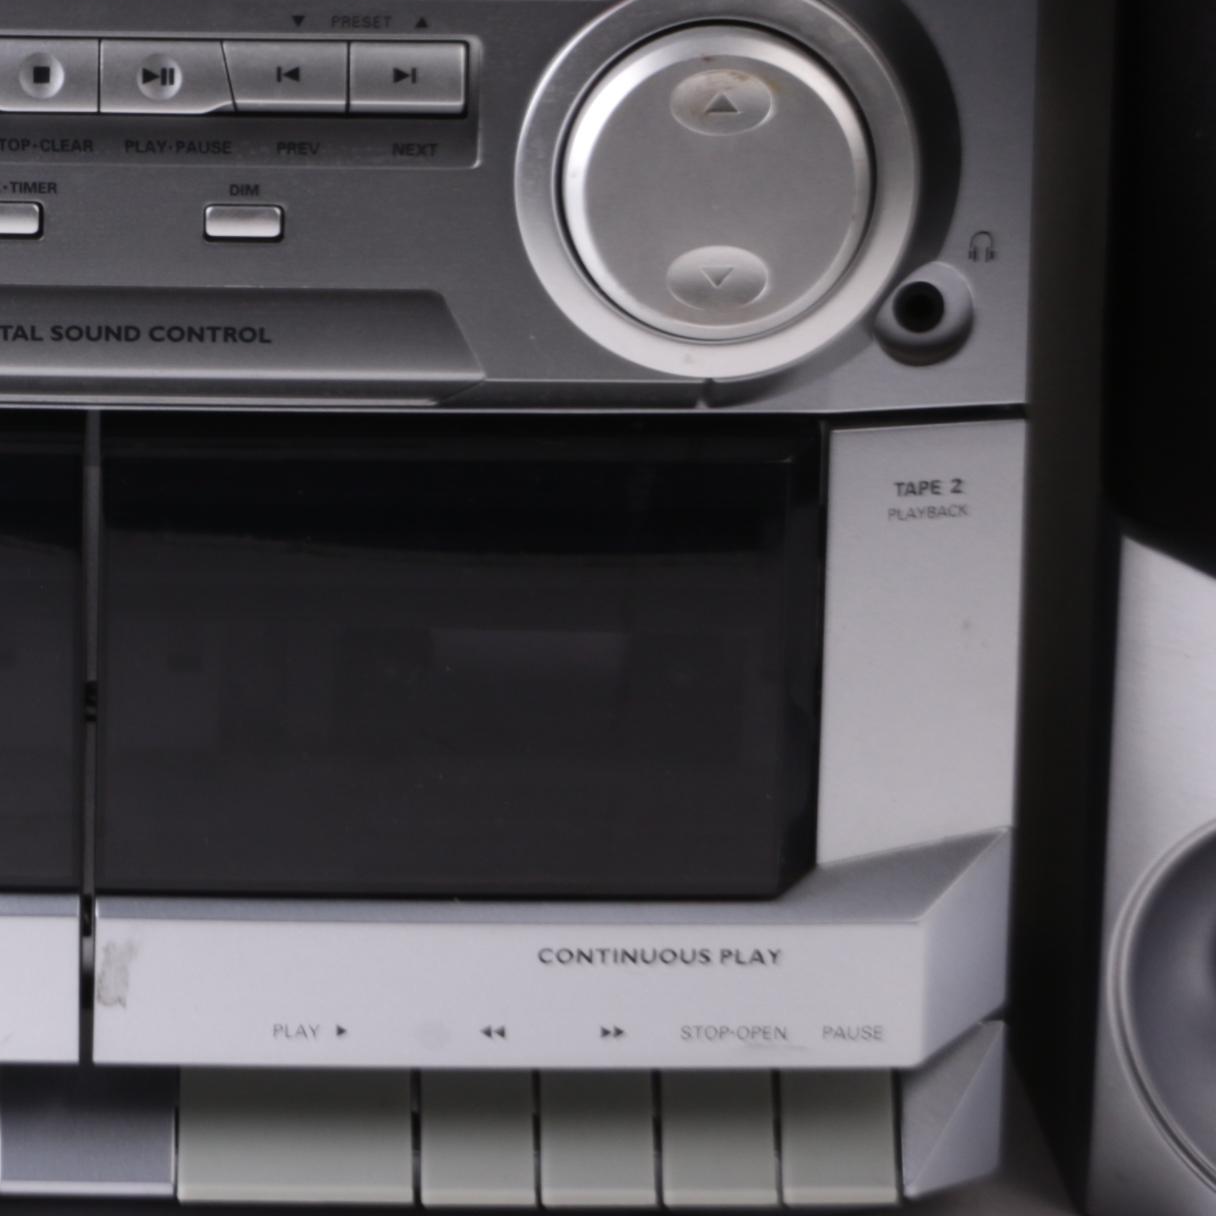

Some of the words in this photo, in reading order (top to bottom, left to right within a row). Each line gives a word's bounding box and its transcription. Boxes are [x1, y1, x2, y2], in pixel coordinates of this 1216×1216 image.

[331, 15, 392, 29] PRESET
[276, 141, 320, 156] PREV
[392, 142, 438, 157] NEXT
[229, 183, 259, 197] DIM
[49, 325, 140, 343] SOUND
[148, 325, 272, 344] CONTROL
[893, 479, 942, 497] TAPE
[950, 477, 964, 494] 2
[887, 504, 968, 522] PLAYBACK
[537, 947, 712, 965] CONTINUOUS
[719, 948, 782, 966] PLAY
[272, 1023, 320, 1039] PLAY
[821, 1025, 884, 1041] PAUSE
